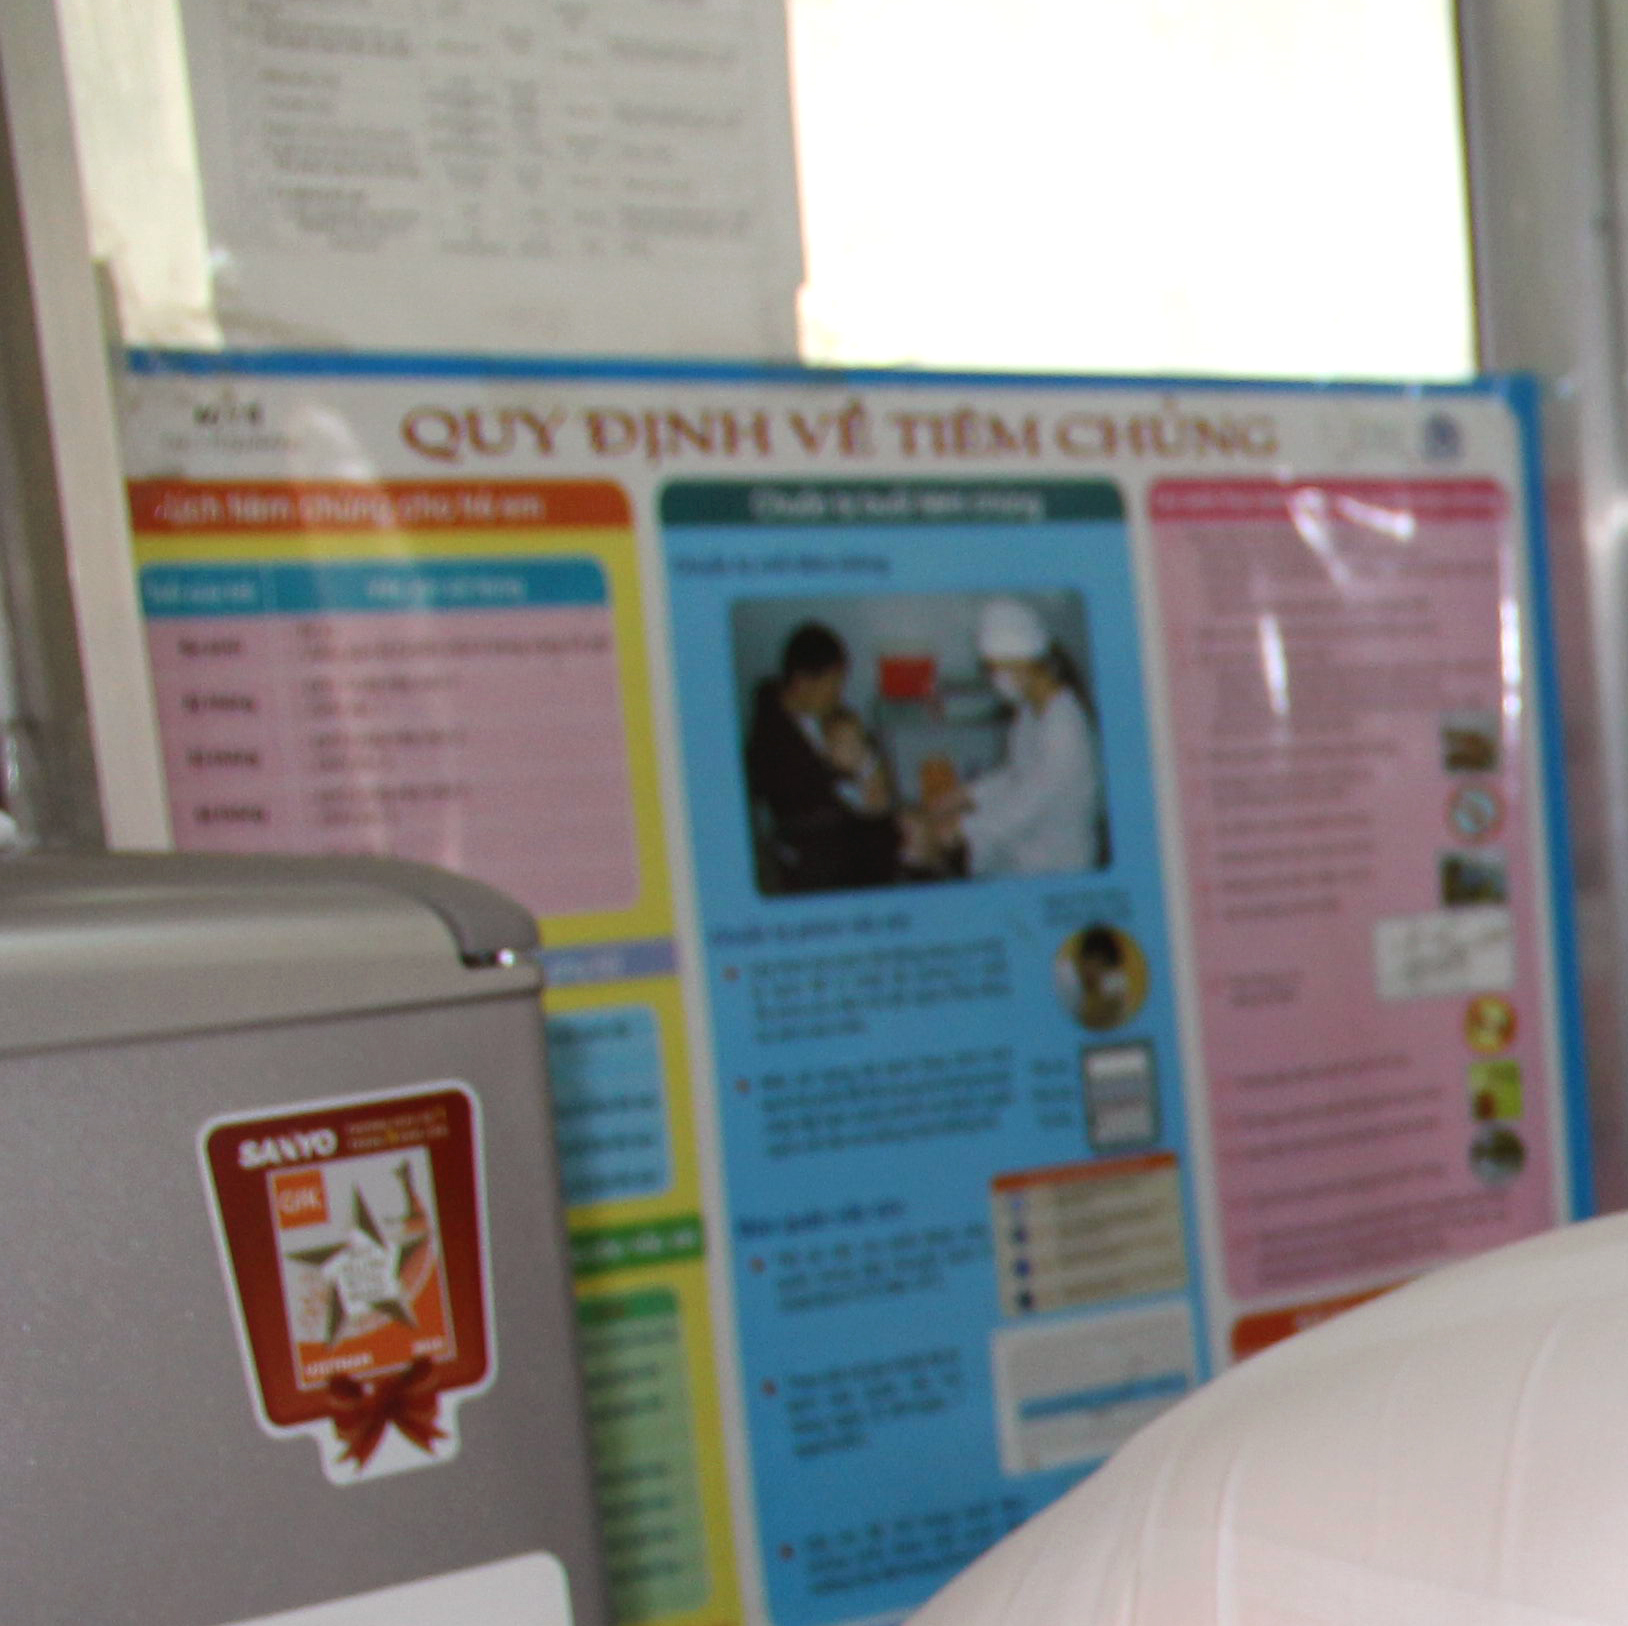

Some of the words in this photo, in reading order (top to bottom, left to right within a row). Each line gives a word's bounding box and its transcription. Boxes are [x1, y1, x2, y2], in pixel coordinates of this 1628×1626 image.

[401, 404, 565, 462] QUY
[585, 405, 771, 465] ĐỊNH
[787, 398, 875, 458] VỀ
[1055, 397, 1281, 458] CHỦNG
[238, 1128, 339, 1169] SANYO
